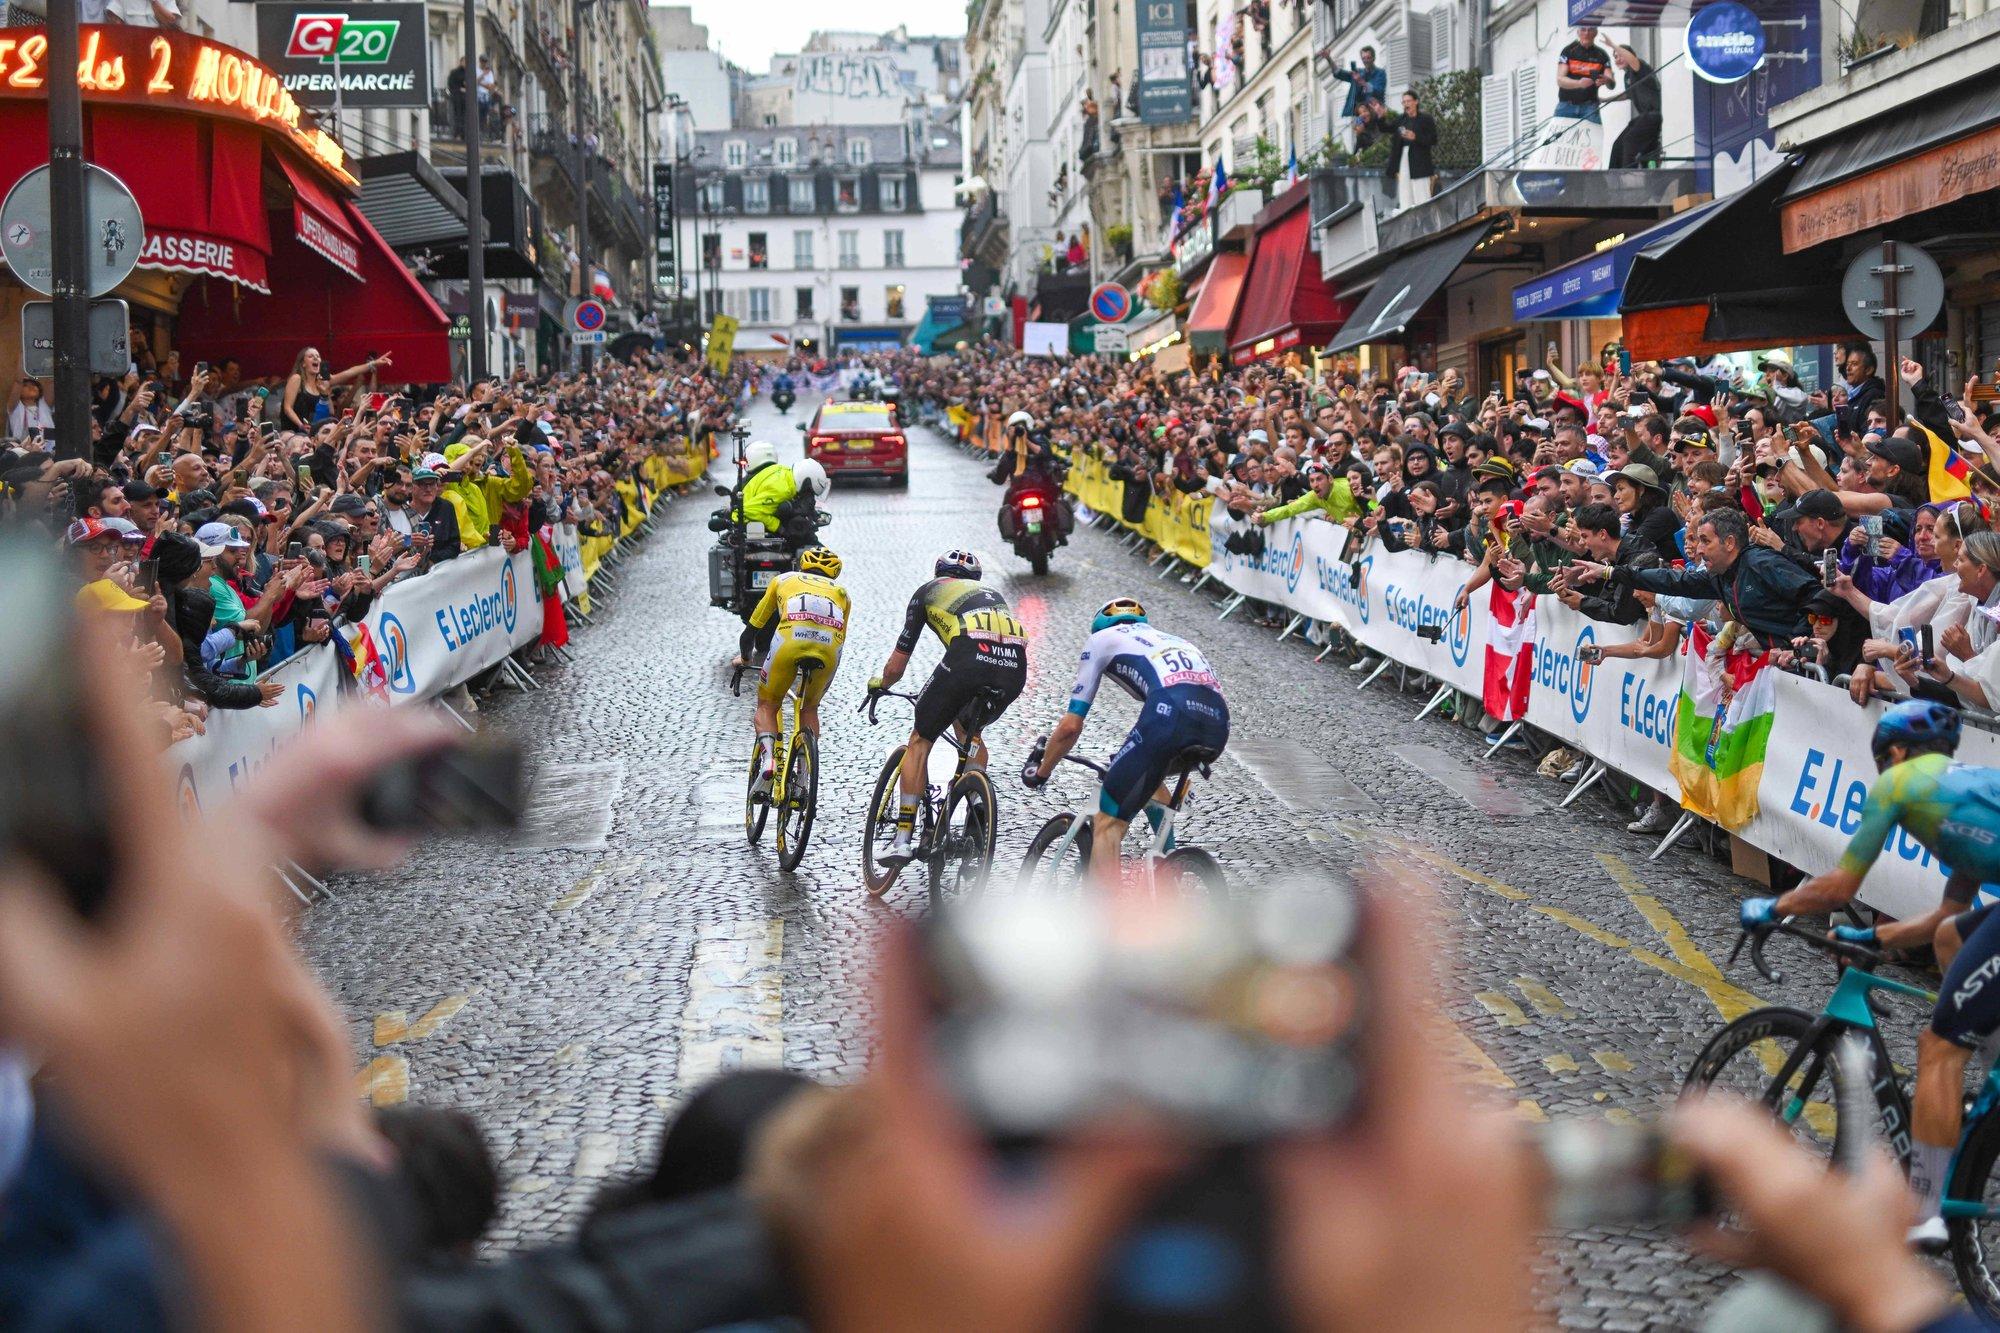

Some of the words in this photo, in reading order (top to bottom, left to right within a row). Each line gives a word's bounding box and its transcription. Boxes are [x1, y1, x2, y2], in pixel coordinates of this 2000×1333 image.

[1696, 31, 1755, 48] amélie
[77, 31, 126, 91] des
[148, 36, 174, 93] 2
[280, 69, 415, 91] UPERMARCHÉ
[140, 236, 233, 269] RASSERIE
[799, 595, 807, 612] 1
[827, 602, 834, 619] 1
[435, 592, 501, 652] E.Leclerc
[972, 612, 992, 632] 17
[991, 645, 1018, 658] VISMA
[1162, 650, 1194, 673] 56
[1116, 663, 1150, 696] BAHRAIN
